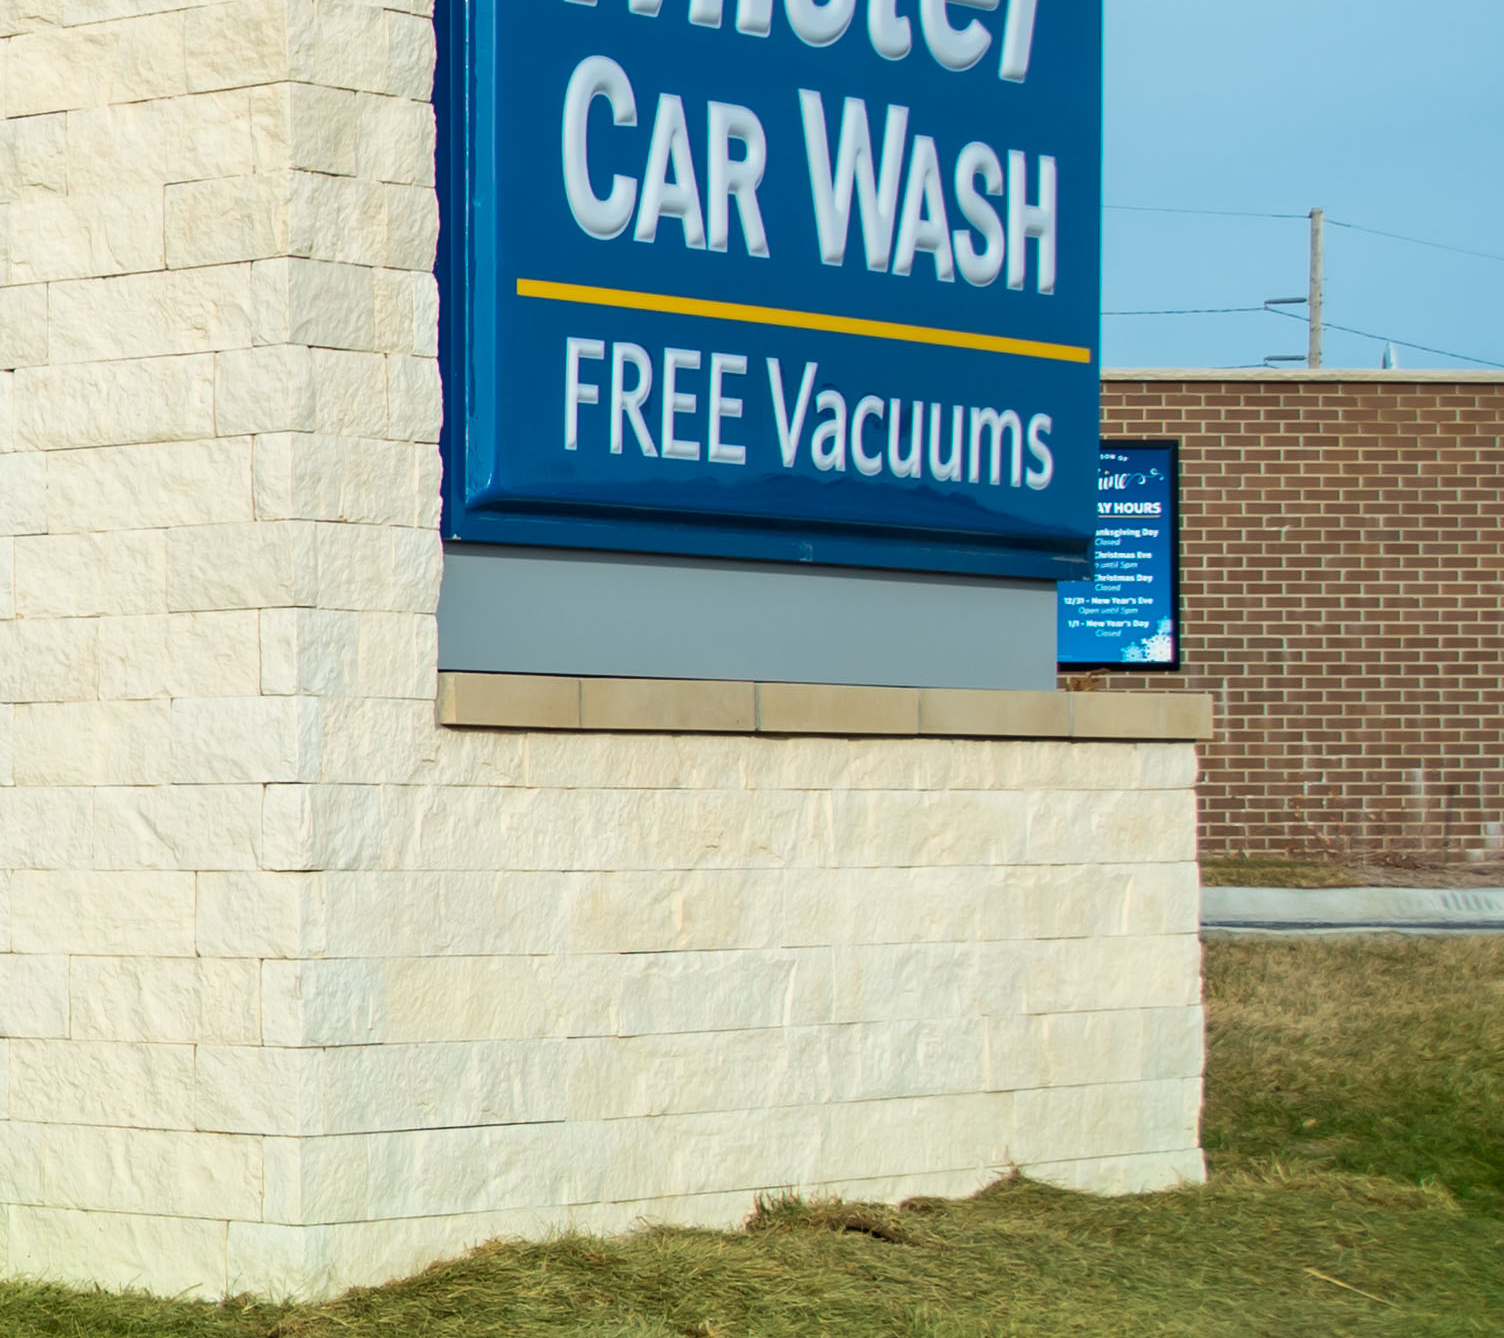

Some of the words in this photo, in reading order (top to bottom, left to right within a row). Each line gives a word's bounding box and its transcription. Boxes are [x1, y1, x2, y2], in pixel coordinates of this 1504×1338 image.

[561, 54, 770, 259] CAR
[798, 88, 1058, 296] WASH
[563, 335, 748, 466] FREE
[765, 356, 1054, 491] Vacuums
[1114, 502, 1162, 514] HOURS
[1095, 528, 1141, 537] anksgiving
[1141, 528, 1159, 538] Day
[1136, 551, 1152, 559] Eve
[1136, 574, 1153, 583] Day
[1132, 620, 1150, 628] Day
[1095, 629, 1122, 637] Closed
